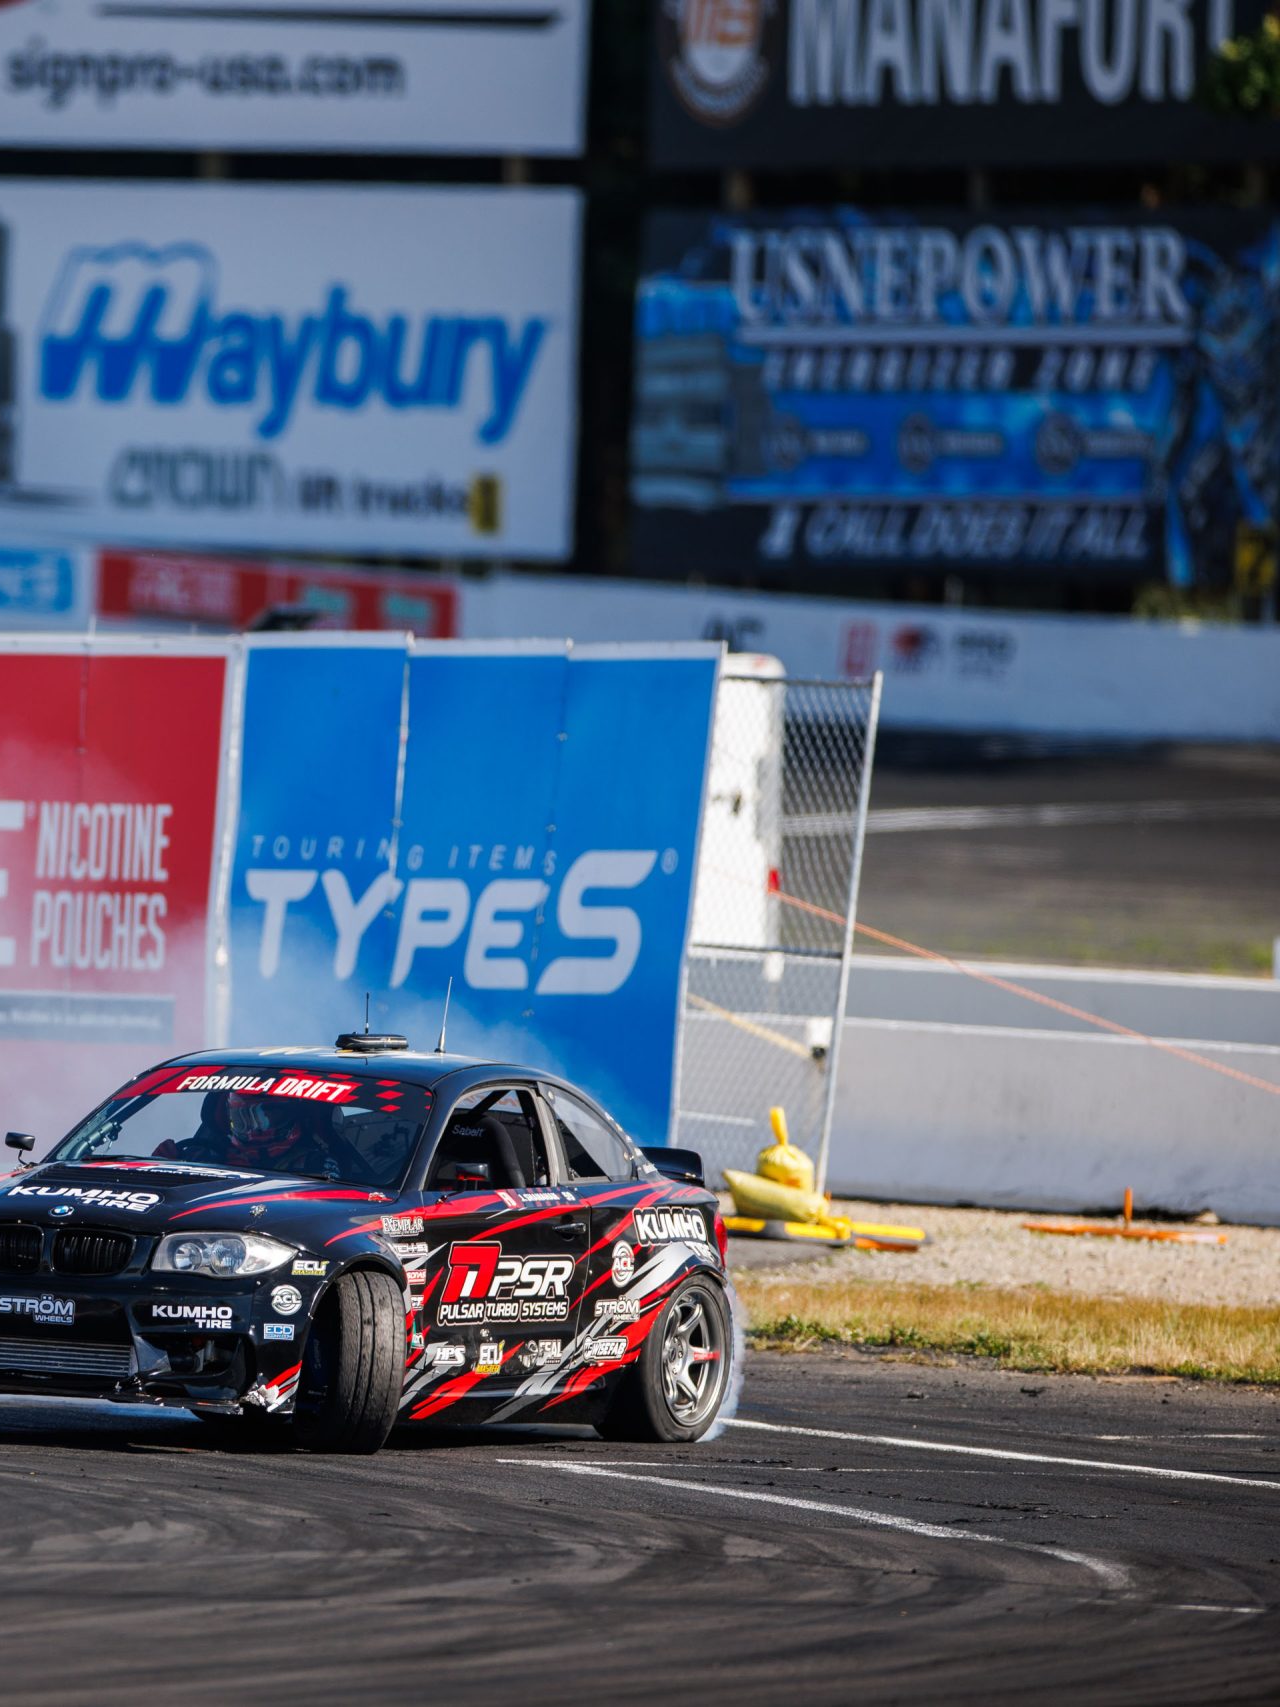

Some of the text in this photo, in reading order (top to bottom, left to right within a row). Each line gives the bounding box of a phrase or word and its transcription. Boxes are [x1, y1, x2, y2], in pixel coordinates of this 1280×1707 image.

[7, 38, 407, 111] signpro-usa.com
[36, 801, 170, 884] NICOTINE
[250, 833, 557, 876] TOURING ITEMS
[32, 889, 168, 971] POUCHES
[176, 1074, 352, 1101] FORMULA DRIFT
[9, 1185, 160, 1205] KUMHO
[79, 1197, 150, 1213] TIRE
[635, 1213, 707, 1242] KUMHO
[293, 1260, 327, 1271] ECU
[612, 1257, 635, 1271] ACL
[489, 1259, 573, 1297] PSR
[152, 1305, 233, 1320] KUMHO
[440, 1301, 567, 1320] PULSAR TURBO SYSTEMS
[595, 1295, 639, 1314] STRÖM
[34, 1313, 73, 1324] WHEELS
[195, 1318, 232, 1330] TIRE
[435, 1346, 466, 1364] HPS
[479, 1342, 504, 1365] ECU
